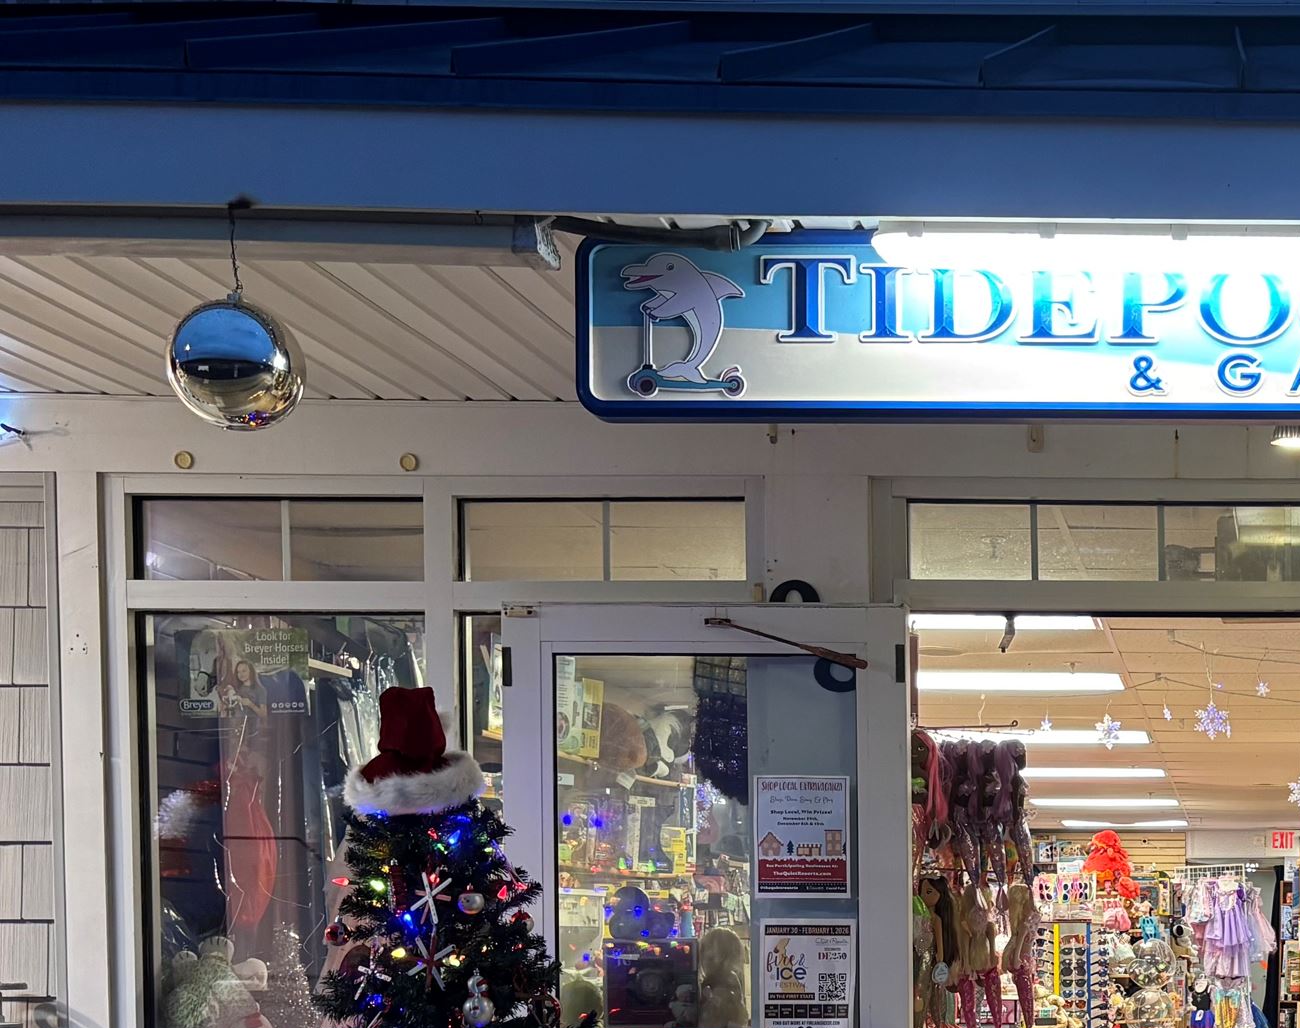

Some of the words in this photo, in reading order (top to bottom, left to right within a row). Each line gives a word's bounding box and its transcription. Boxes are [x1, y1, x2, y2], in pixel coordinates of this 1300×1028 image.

[1129, 352, 1169, 396] &
[256, 631, 277, 640] Look
[279, 631, 291, 640] for
[244, 643, 273, 654] Breyer
[275, 642, 304, 652] Horses
[260, 655, 290, 665] Inside!
[183, 701, 213, 710] Breyer
[1272, 832, 1295, 849] EXIT
